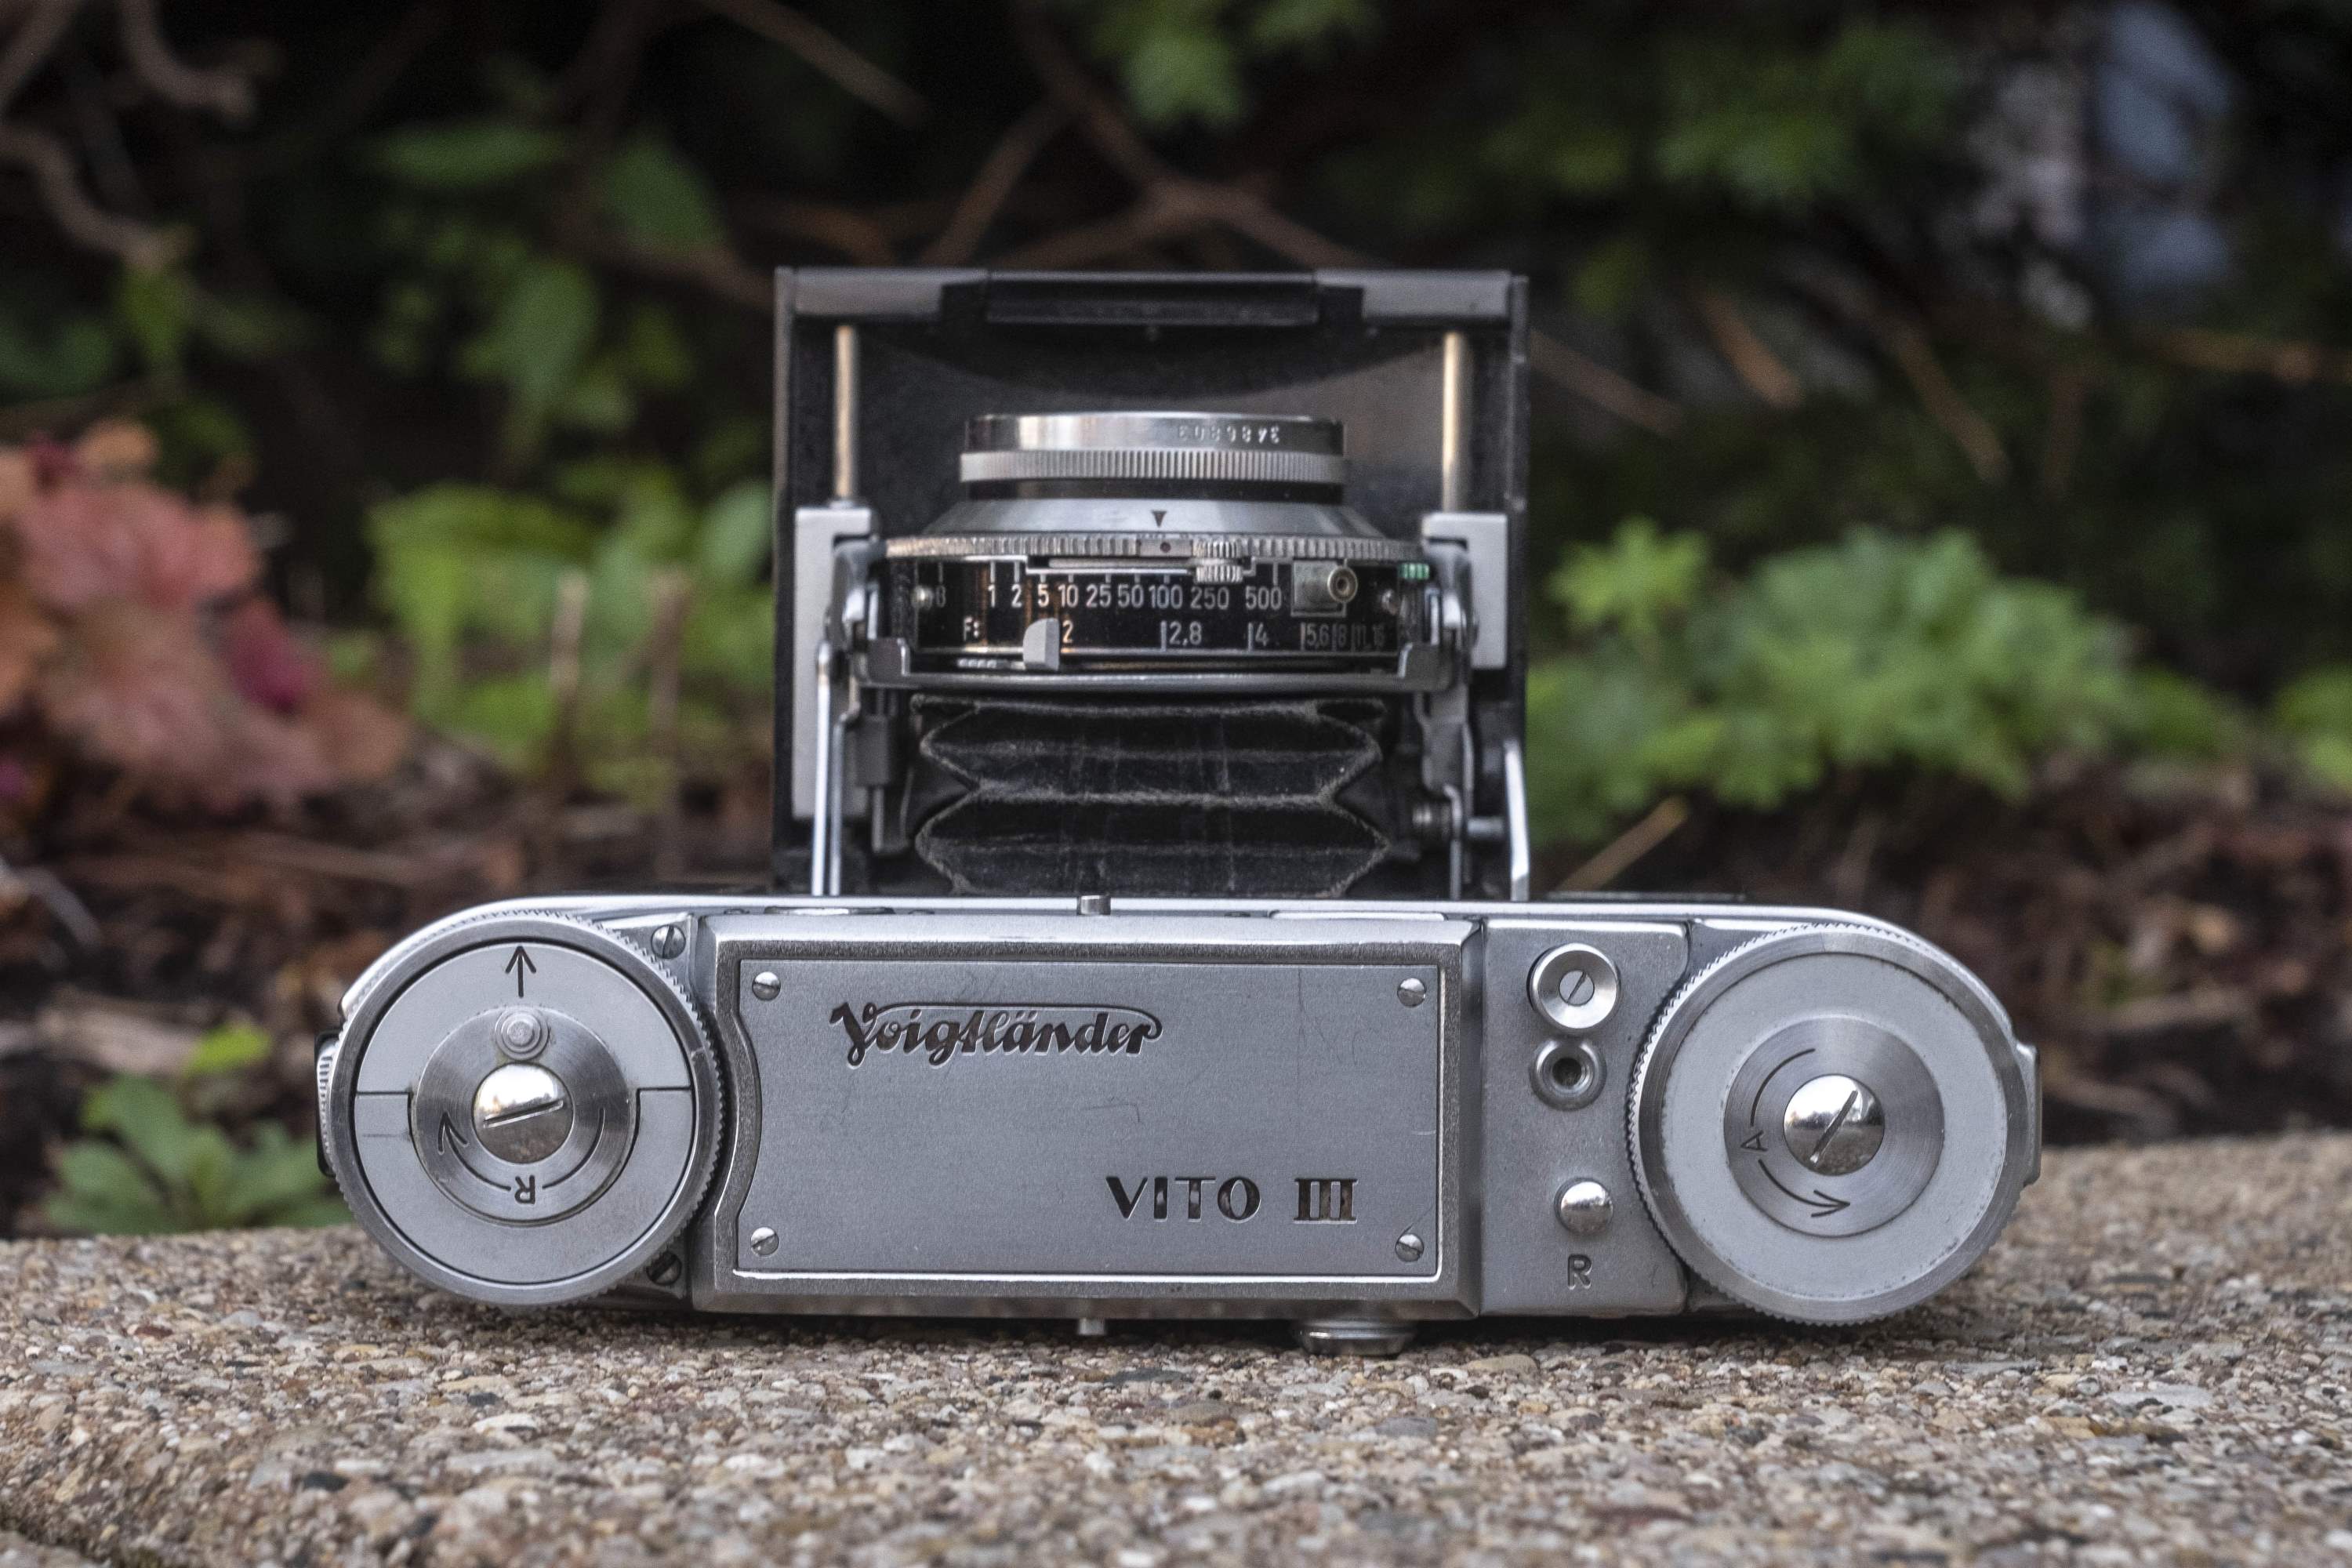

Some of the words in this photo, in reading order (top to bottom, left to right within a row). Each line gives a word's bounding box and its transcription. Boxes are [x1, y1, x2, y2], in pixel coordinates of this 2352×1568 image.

[988, 584, 996, 608] 1
[1011, 584, 1022, 608] 2
[1037, 583, 1049, 607] 5
[1058, 584, 1079, 608] 10
[1086, 584, 1112, 608] 25
[1117, 585, 1144, 608] 50
[1149, 585, 1183, 609] 100
[1190, 586, 1229, 610] 250
[1245, 586, 1282, 610] 500
[1062, 619, 1074, 644] 2
[1169, 621, 1202, 646] 2,8
[1255, 622, 1269, 647] 4
[829, 999, 1163, 1069] Voigtländer
[1740, 1130, 1768, 1153] A
[514, 1174, 536, 1206] R
[1105, 1175, 1261, 1224] VITO
[1293, 1177, 1358, 1225] III
[1567, 1254, 1594, 1290] R
